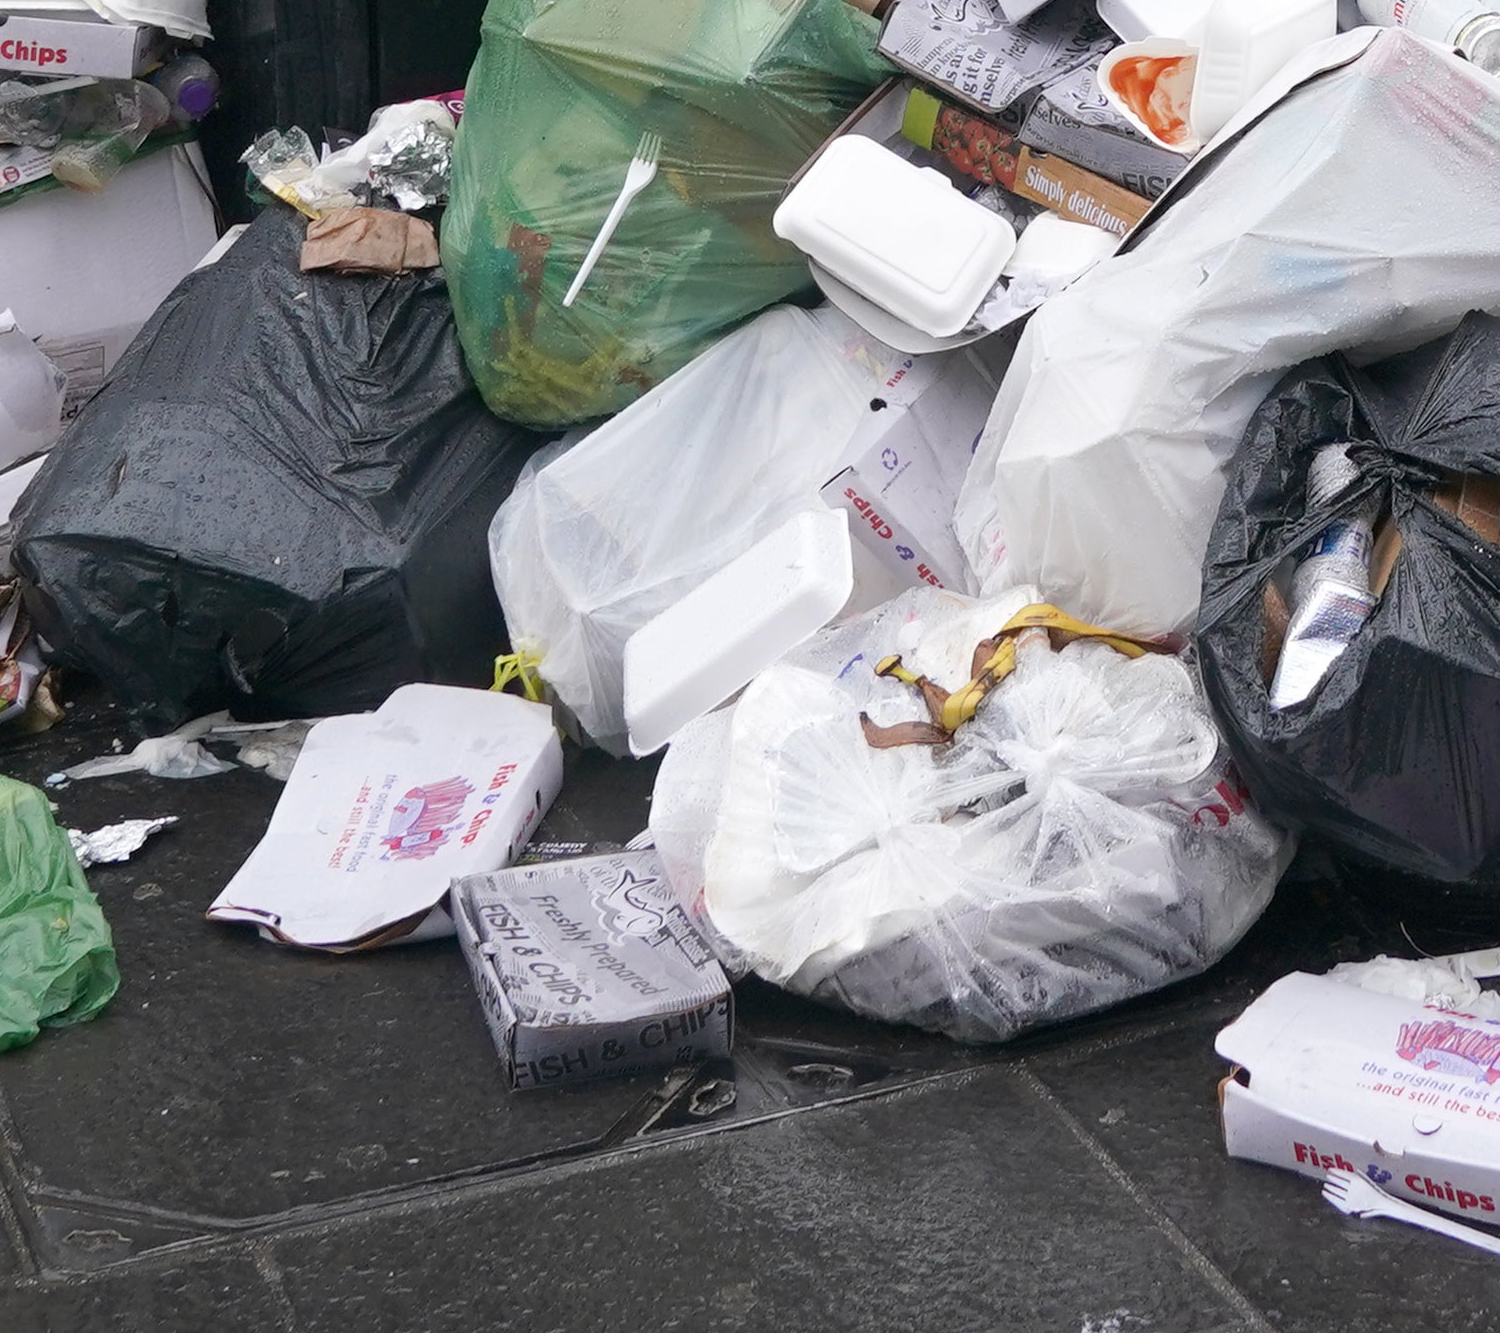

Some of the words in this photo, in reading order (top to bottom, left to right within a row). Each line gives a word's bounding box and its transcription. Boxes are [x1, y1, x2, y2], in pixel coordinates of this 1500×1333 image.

[0, 39, 68, 67] Chips
[1023, 164, 1068, 208] Simply
[1067, 189, 1132, 234] delicious
[886, 368, 907, 388] Fish
[842, 486, 895, 541] Chips
[895, 544, 915, 561] &
[488, 761, 518, 792] Fish
[481, 792, 501, 805] &
[479, 902, 527, 942] FISH
[512, 945, 543, 958] &
[528, 961, 593, 1007] CHIPS
[529, 894, 592, 951] Freshly
[588, 941, 669, 997] Prepared
[514, 1046, 589, 1085] FISH
[601, 1039, 627, 1062] &
[638, 997, 730, 1050] CHIPS
[1360, 1060, 1388, 1078] the
[1392, 1069, 1455, 1096] original
[1458, 1084, 1490, 1103] fast
[1407, 1088, 1441, 1108] still
[1445, 1098, 1471, 1114] the
[1293, 1141, 1355, 1174] Fish
[1365, 1163, 1393, 1184] &
[1404, 1172, 1496, 1213] Chips
